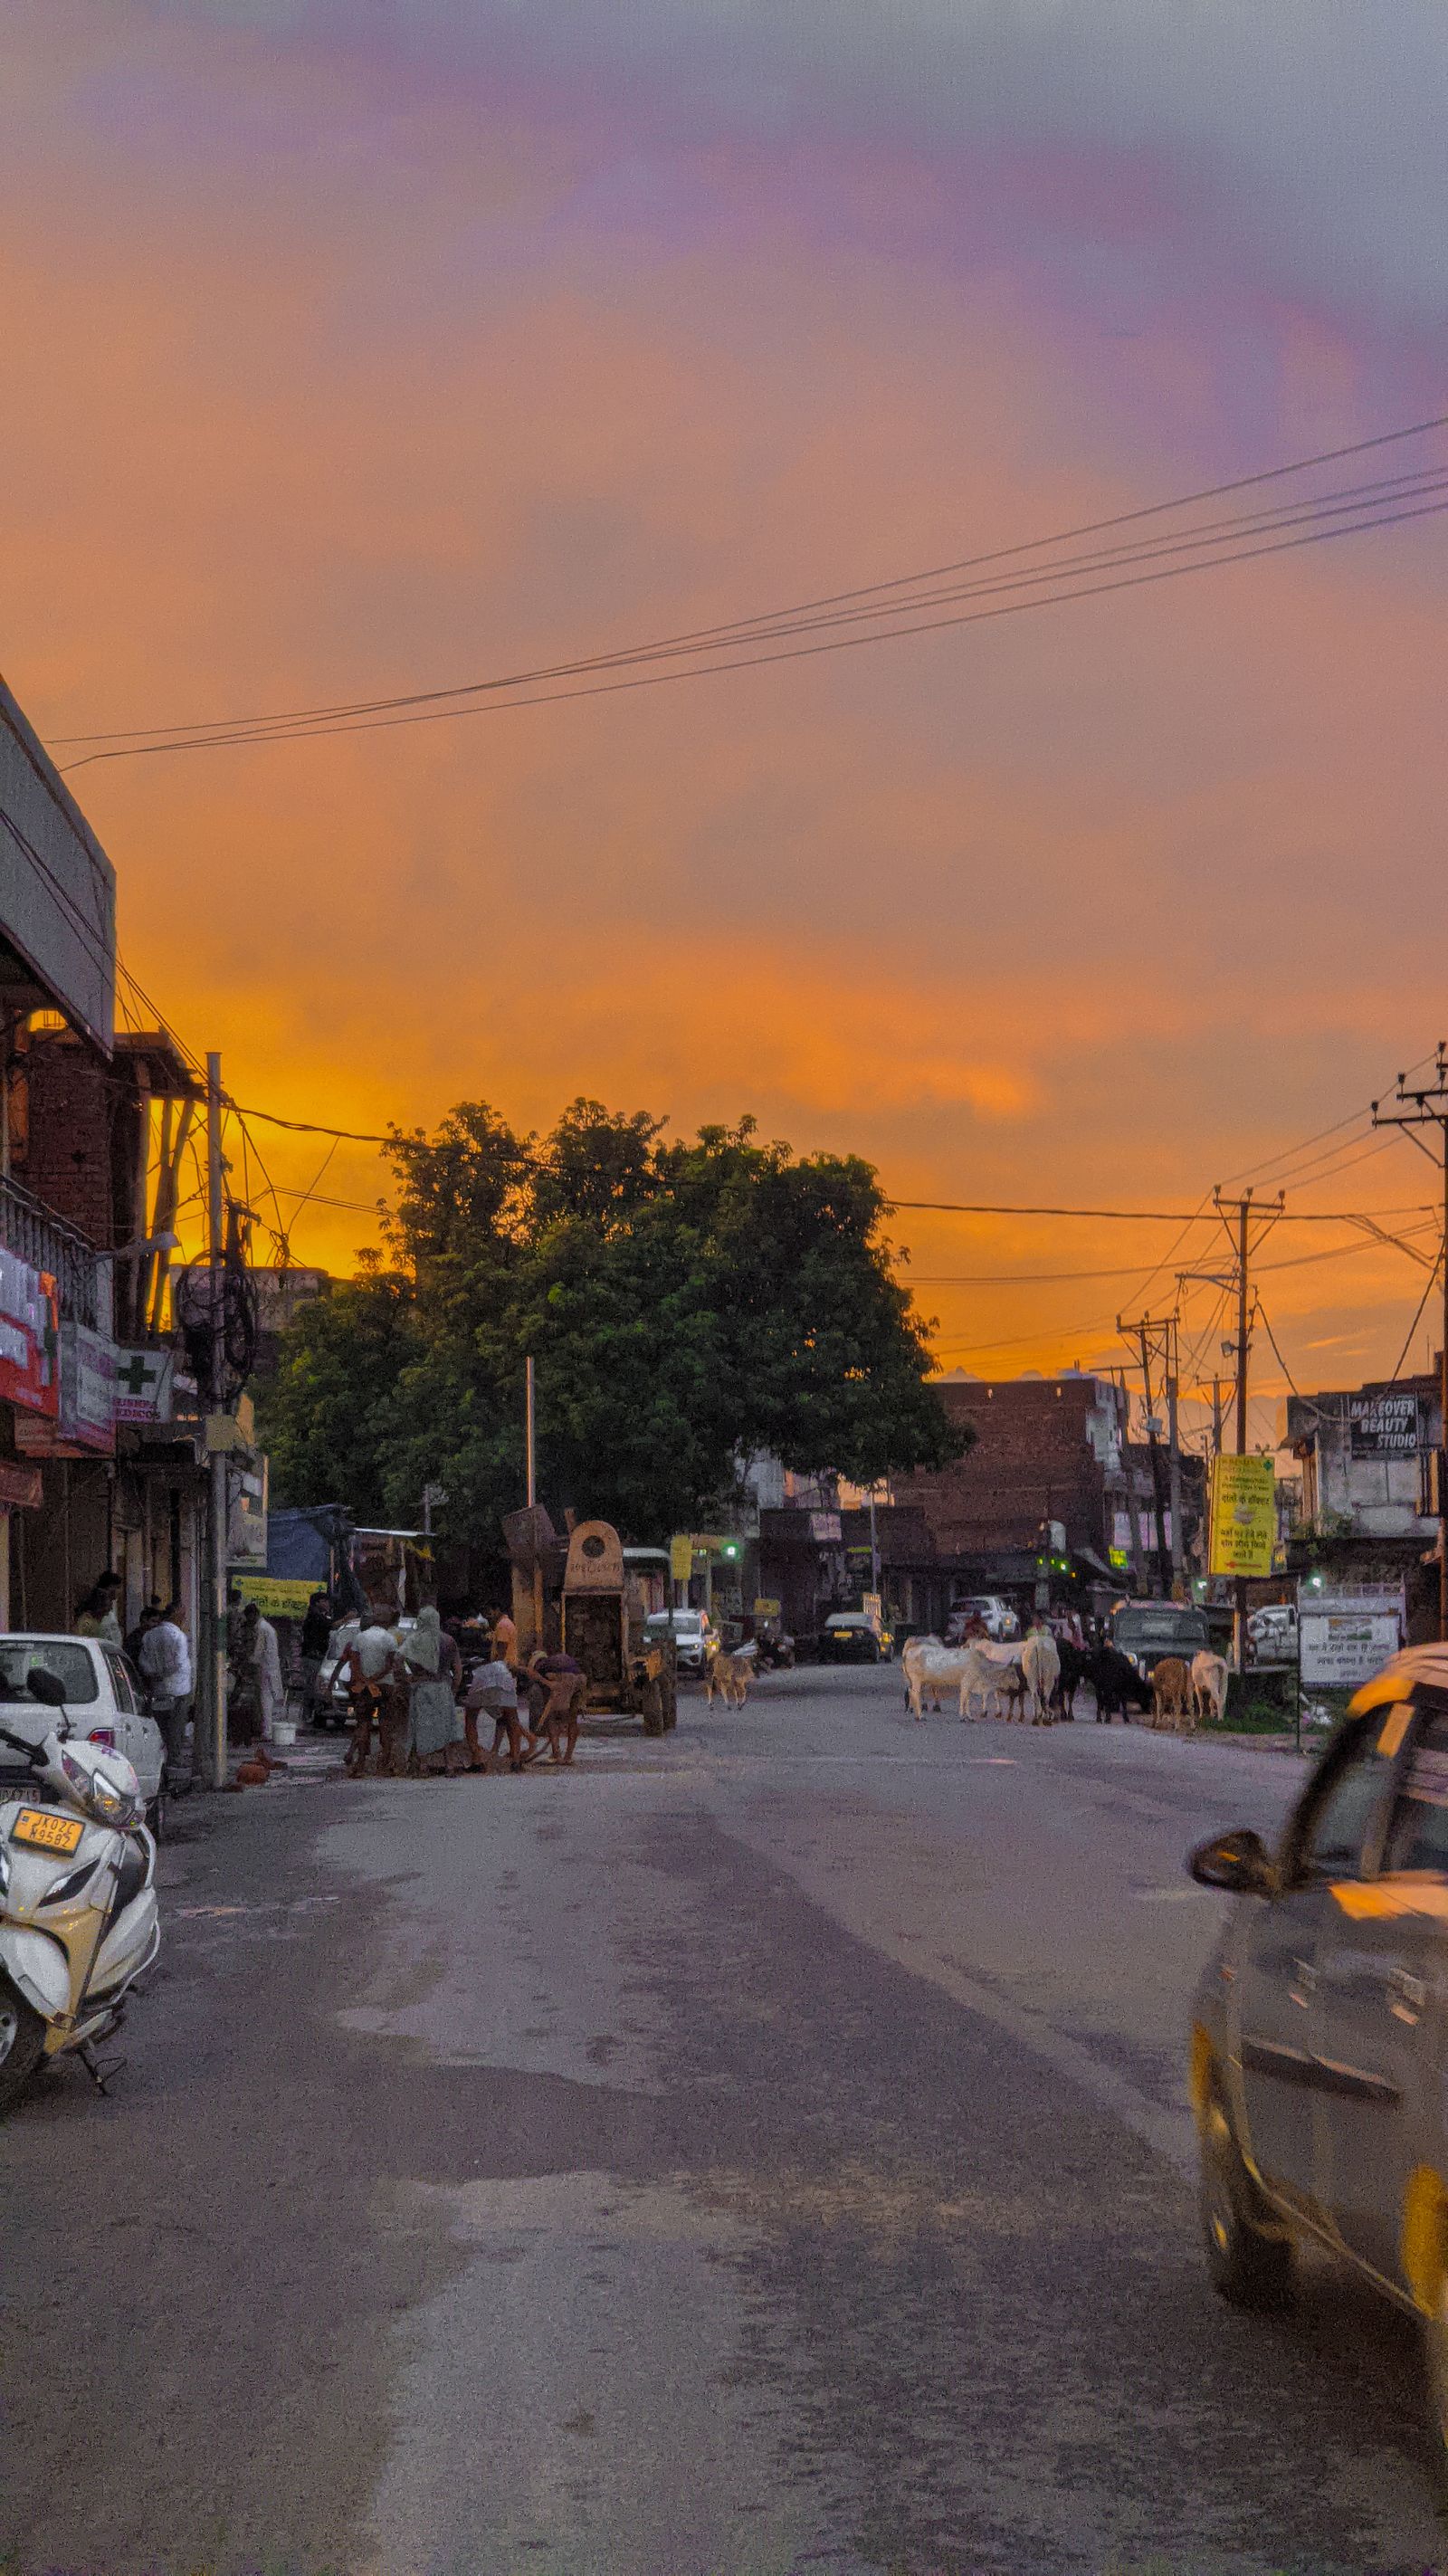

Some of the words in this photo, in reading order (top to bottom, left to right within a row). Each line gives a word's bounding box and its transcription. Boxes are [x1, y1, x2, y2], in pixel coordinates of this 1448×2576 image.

[115, 1408, 161, 1419] EDICOS
[1351, 1399, 1415, 1417] MAKEOVER
[1361, 1417, 1407, 1434] BEAUTY
[1377, 1433, 1416, 1448] STUDIO
